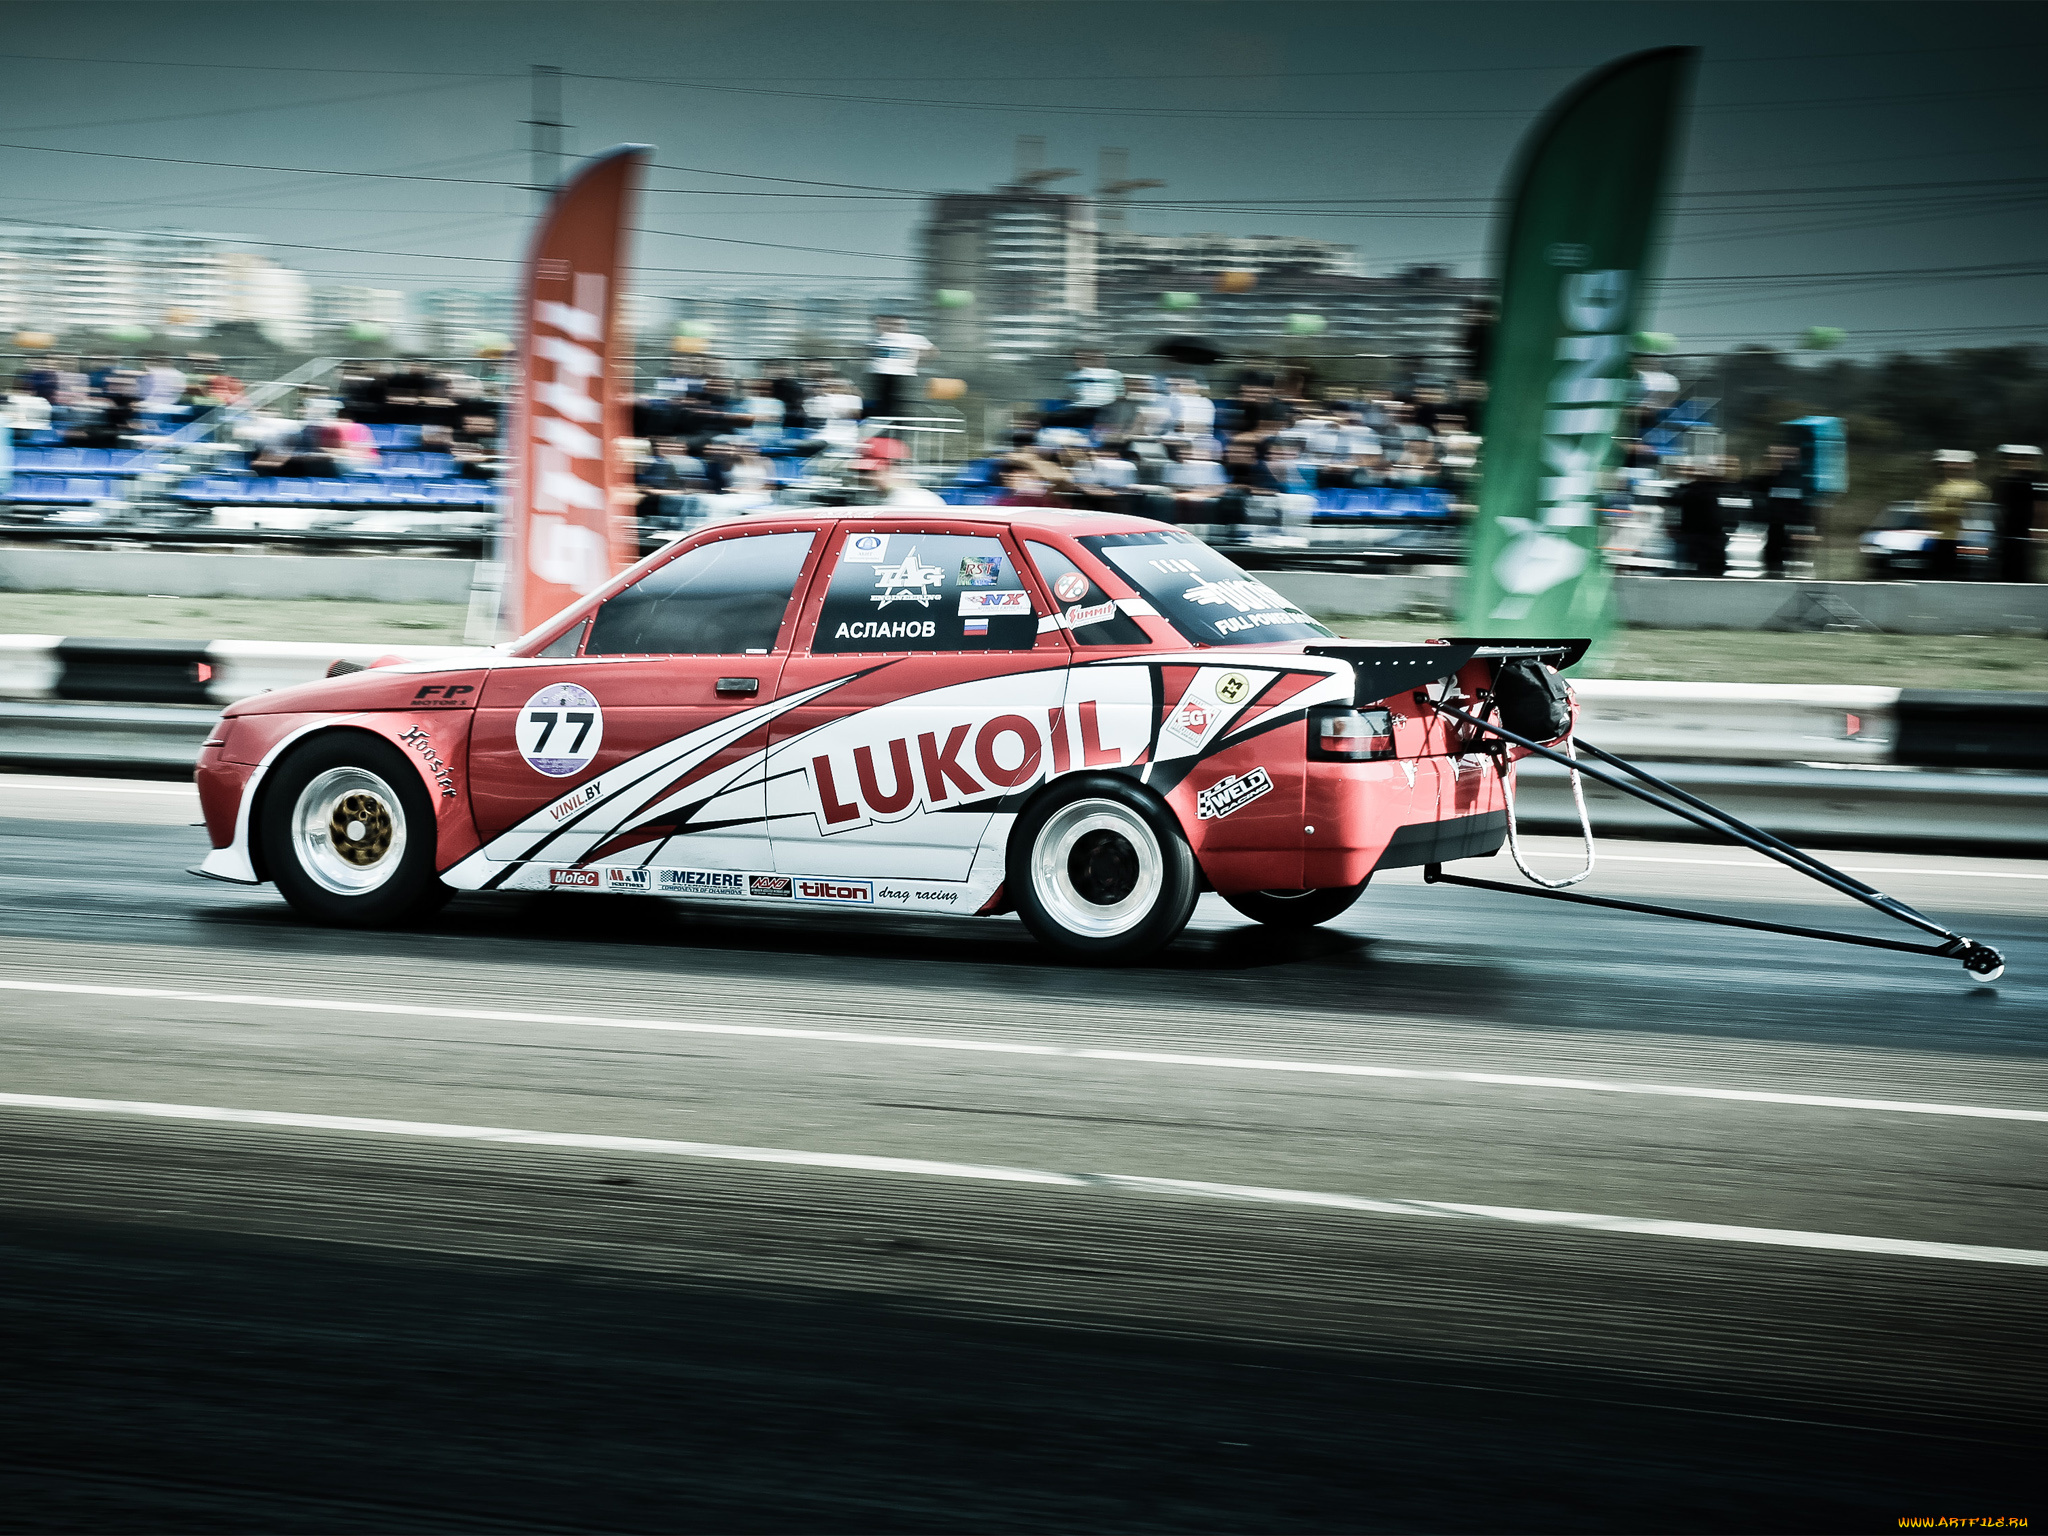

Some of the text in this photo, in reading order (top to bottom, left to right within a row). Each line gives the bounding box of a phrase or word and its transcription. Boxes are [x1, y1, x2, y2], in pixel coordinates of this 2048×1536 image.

[528, 272, 611, 596] STIHL
[965, 563, 994, 575] RST
[981, 593, 1024, 606] NX
[834, 620, 936, 639] АСЛАНОВ
[1214, 615, 1255, 636] FULL
[414, 685, 475, 699] FP
[529, 712, 595, 754] 77
[812, 700, 1121, 825] LUKOIL
[1211, 770, 1266, 808] WELD
[550, 781, 602, 820] VINIL.BY
[1220, 783, 1269, 815] RACING
[554, 871, 596, 885] MoTeC
[672, 870, 743, 887] MEZIERE
[799, 882, 868, 900] tilton
[878, 886, 959, 905] drag racing
